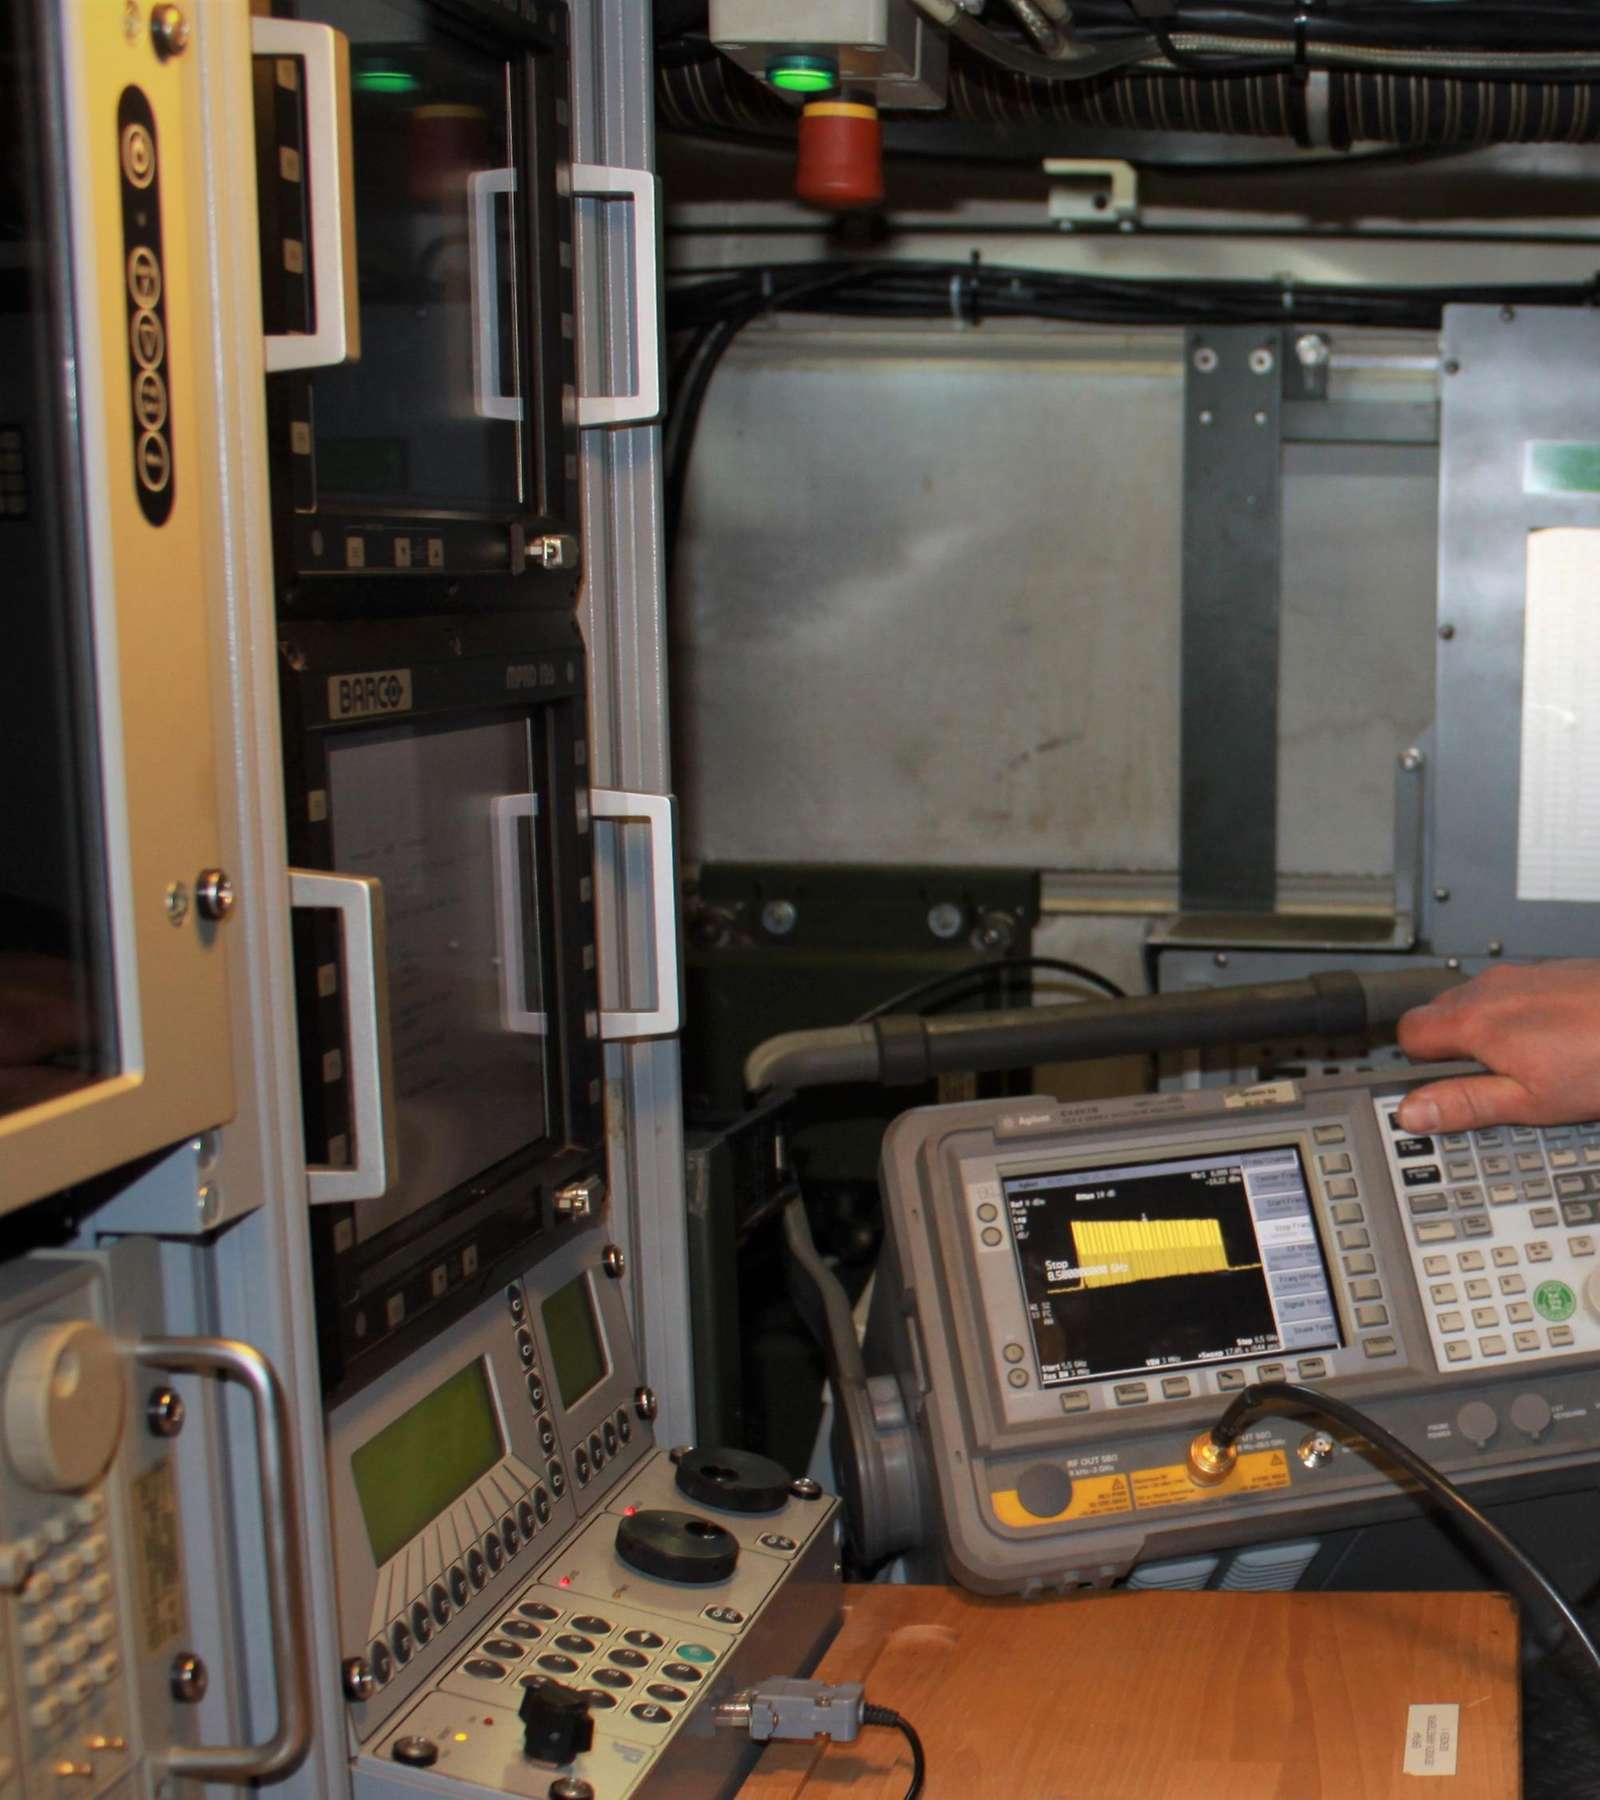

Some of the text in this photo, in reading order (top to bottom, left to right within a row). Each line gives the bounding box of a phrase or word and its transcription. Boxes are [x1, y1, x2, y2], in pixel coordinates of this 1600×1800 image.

[339, 674, 404, 715] BARCO
[1019, 1114, 1050, 1126] Agilent
[1045, 1260, 1069, 1270] Stop
[1081, 1456, 1099, 1466] OUT
